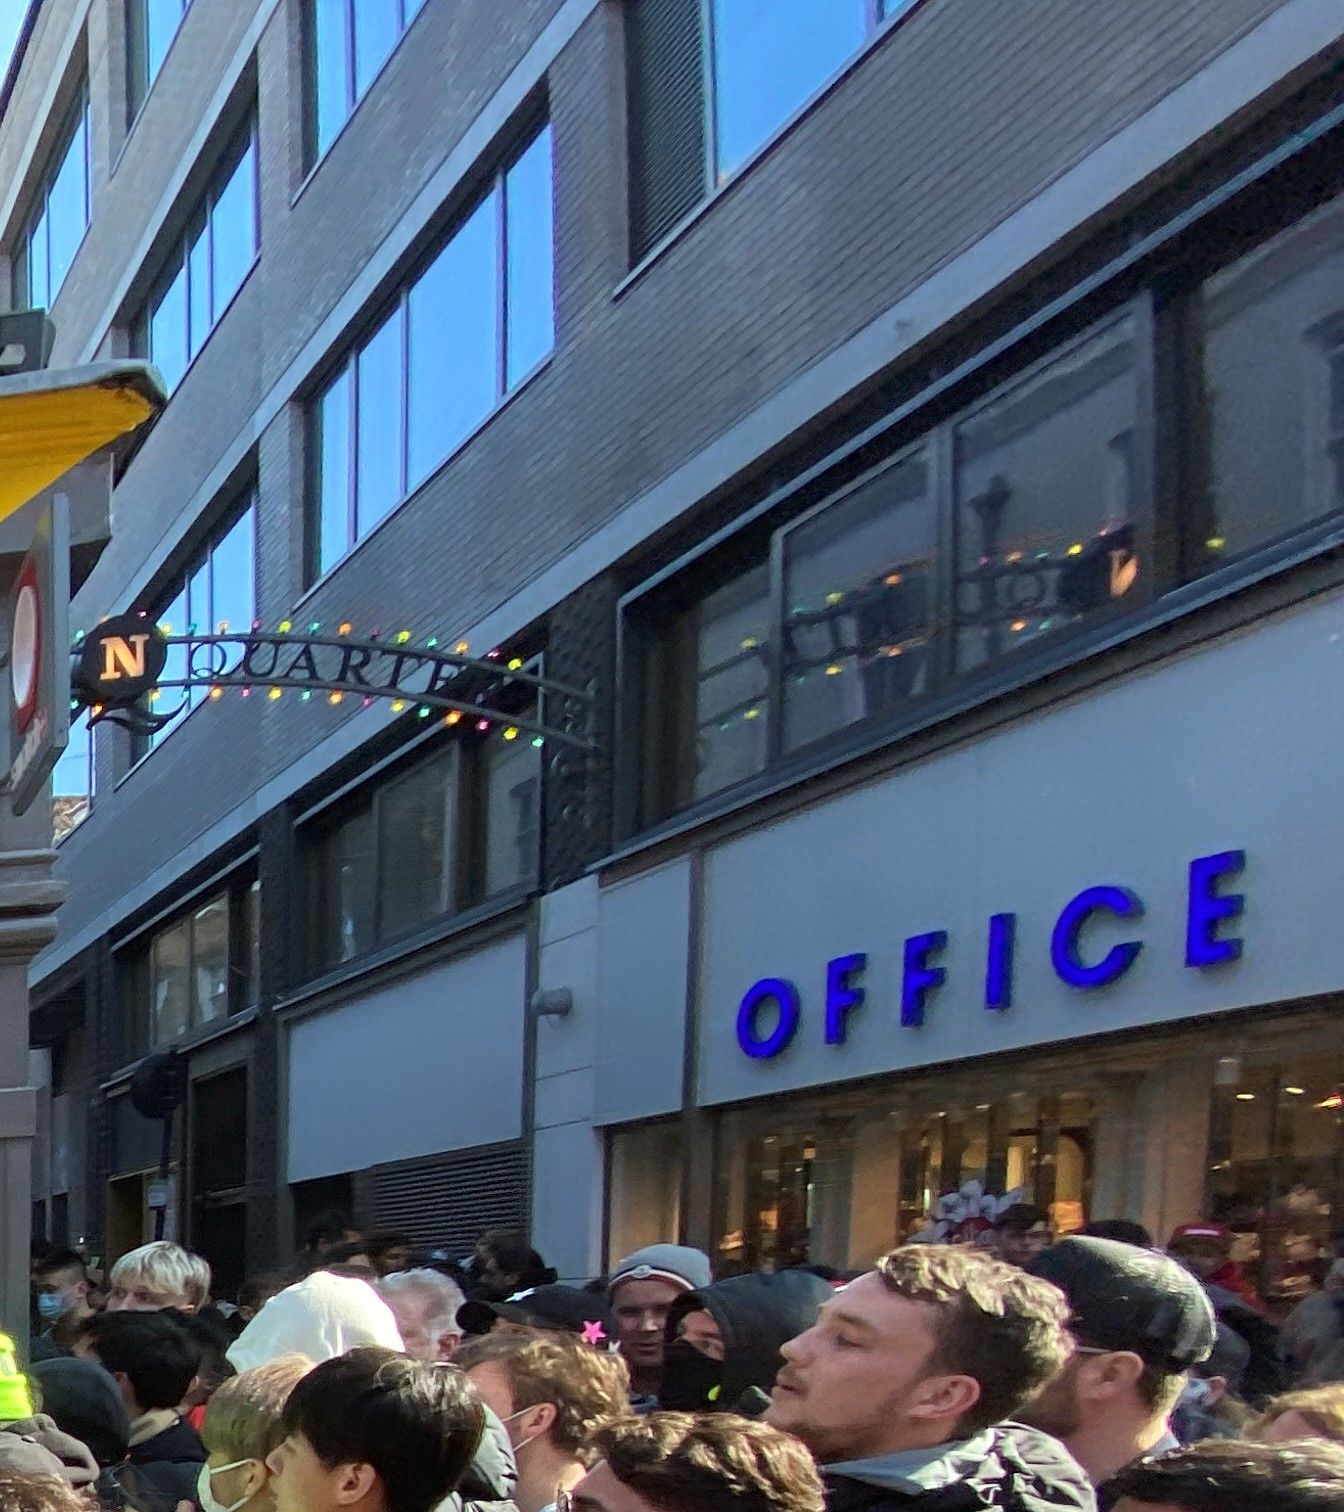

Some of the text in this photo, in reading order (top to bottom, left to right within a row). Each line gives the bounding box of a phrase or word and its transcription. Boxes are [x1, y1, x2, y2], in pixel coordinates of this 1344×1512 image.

[98, 633, 487, 702] N QUARTE
[736, 848, 1247, 1060] OFFICE
